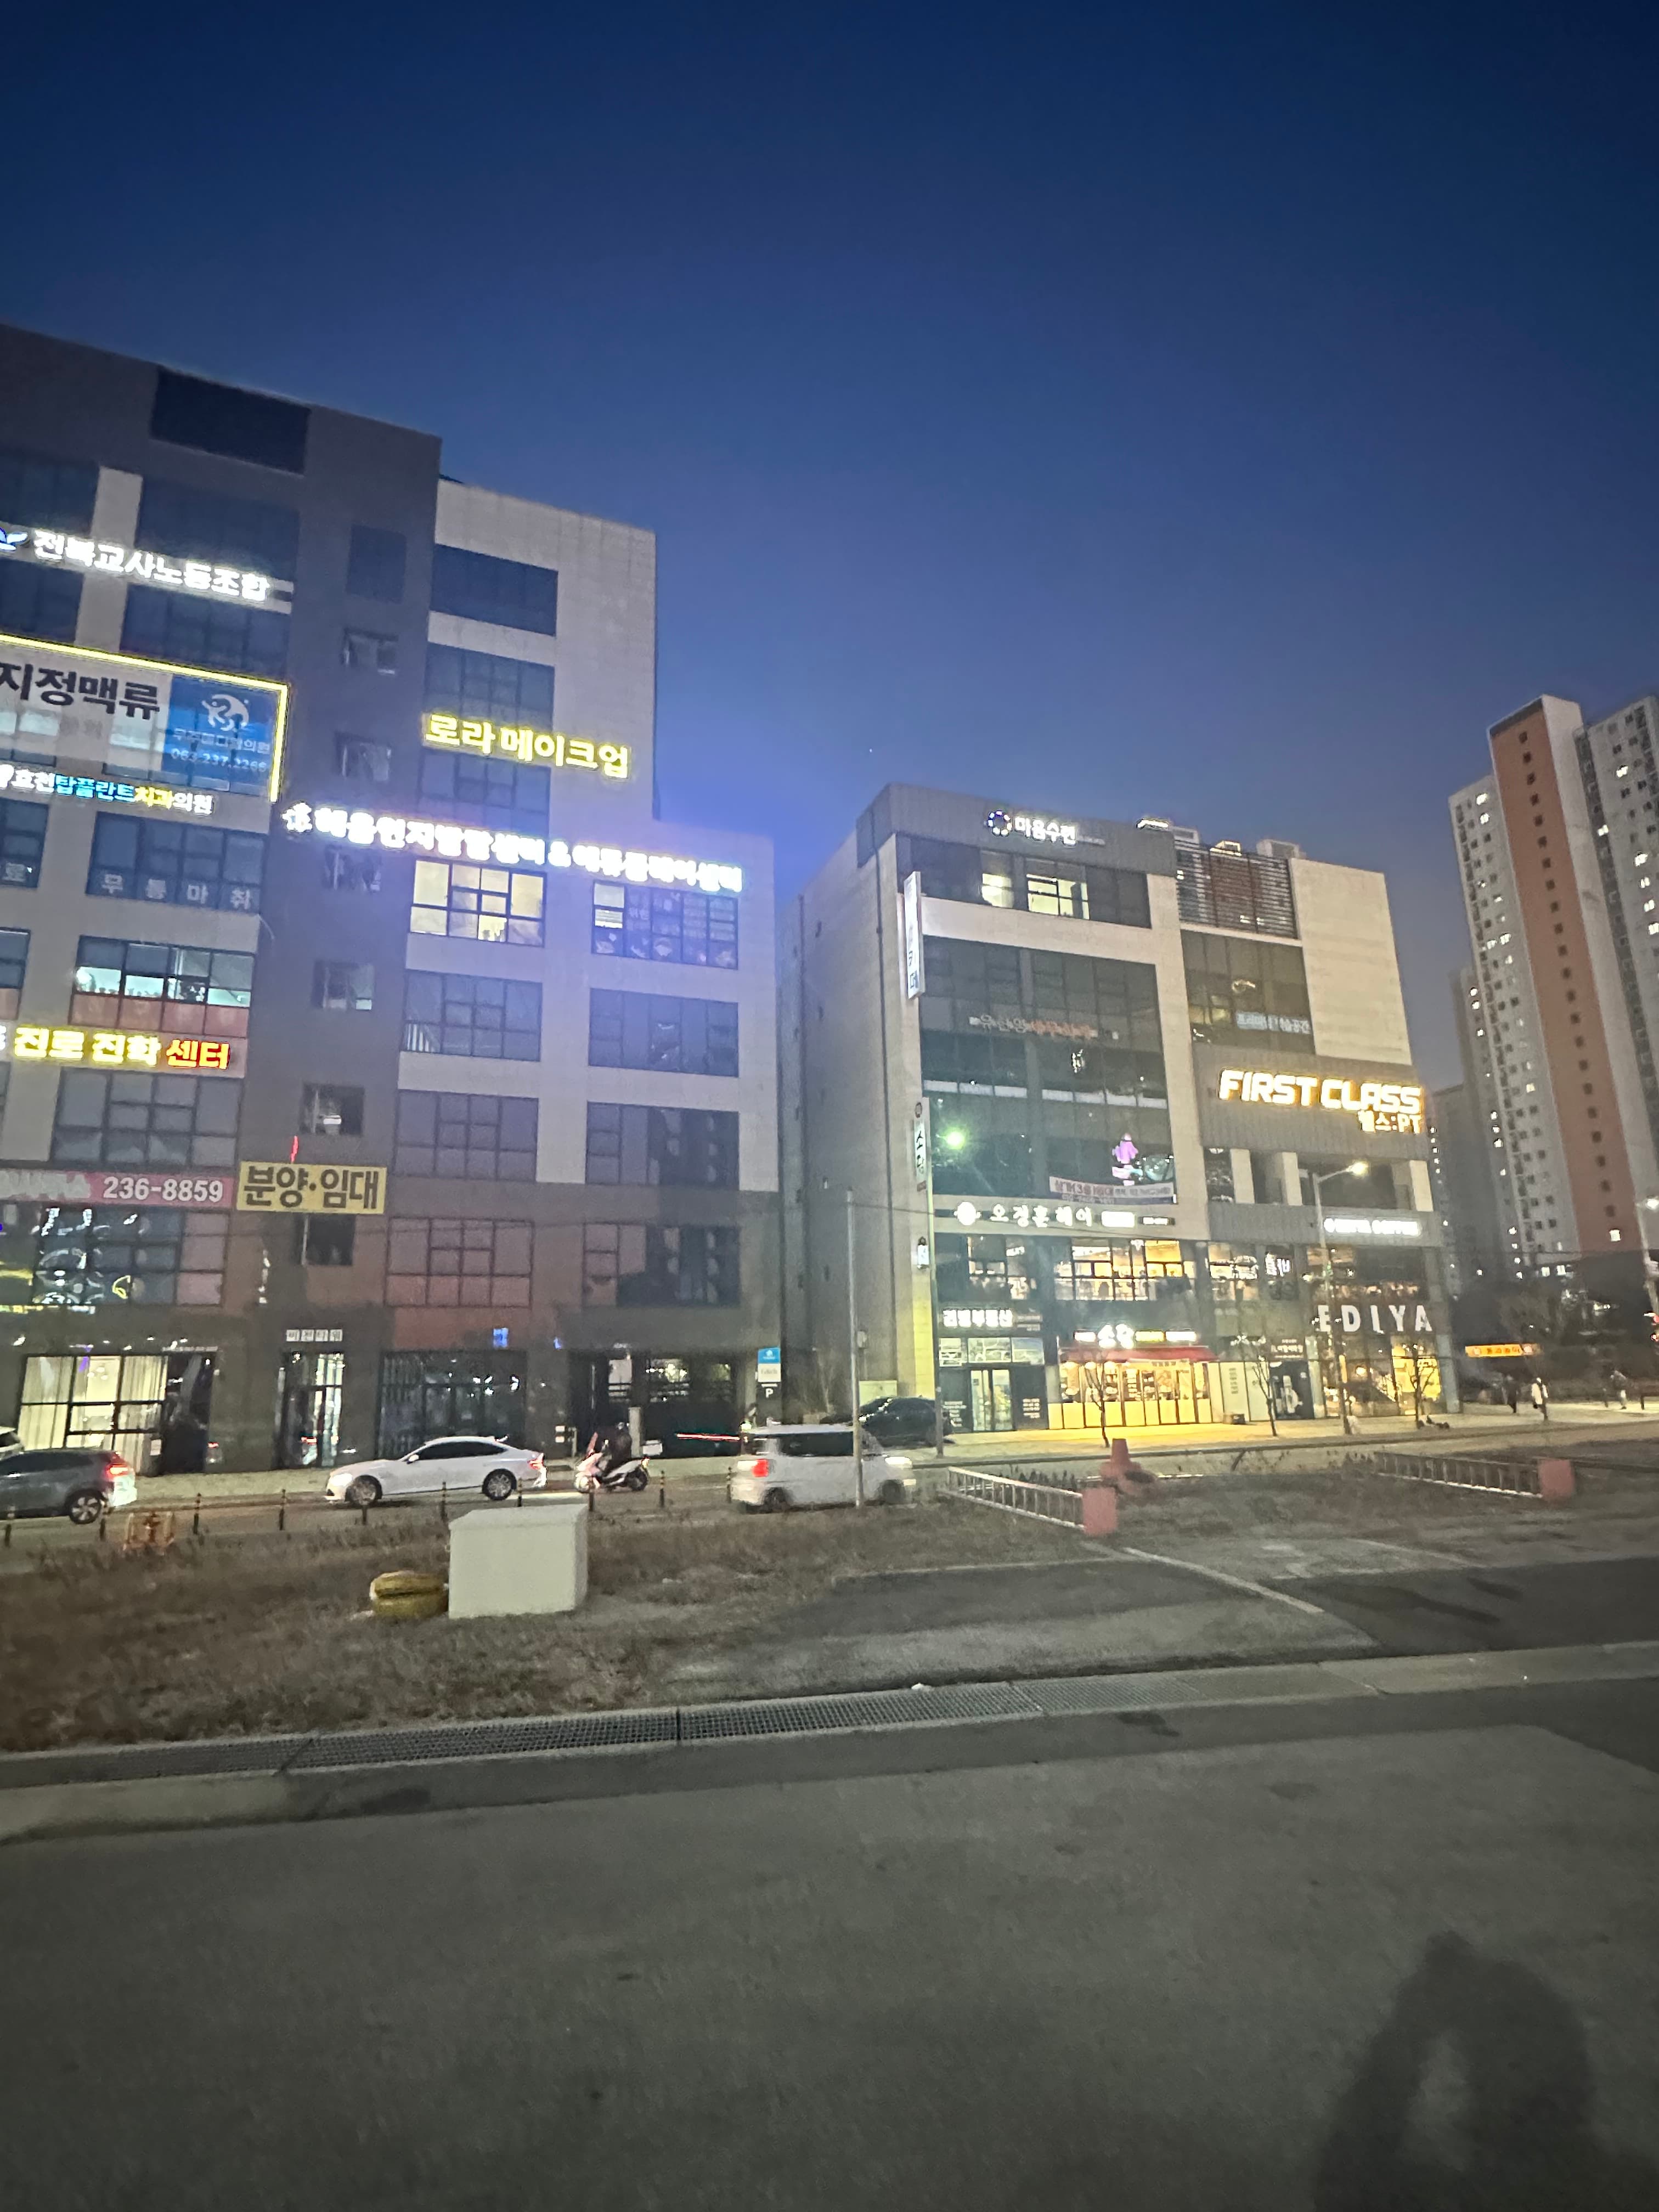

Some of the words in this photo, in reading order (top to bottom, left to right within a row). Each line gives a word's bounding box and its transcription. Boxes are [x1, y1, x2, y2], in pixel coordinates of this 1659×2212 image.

[34, 529, 269, 601] 전북교사노동조합
[425, 714, 496, 755] 로라
[500, 727, 629, 778] 메이크업
[166, 1039, 230, 1070] 센터
[1218, 1069, 1318, 1107] FIRST
[1321, 1079, 1423, 1114] CLASS
[103, 1176, 223, 1203] 236-8859
[1318, 1305, 1433, 1333] EDIYA
